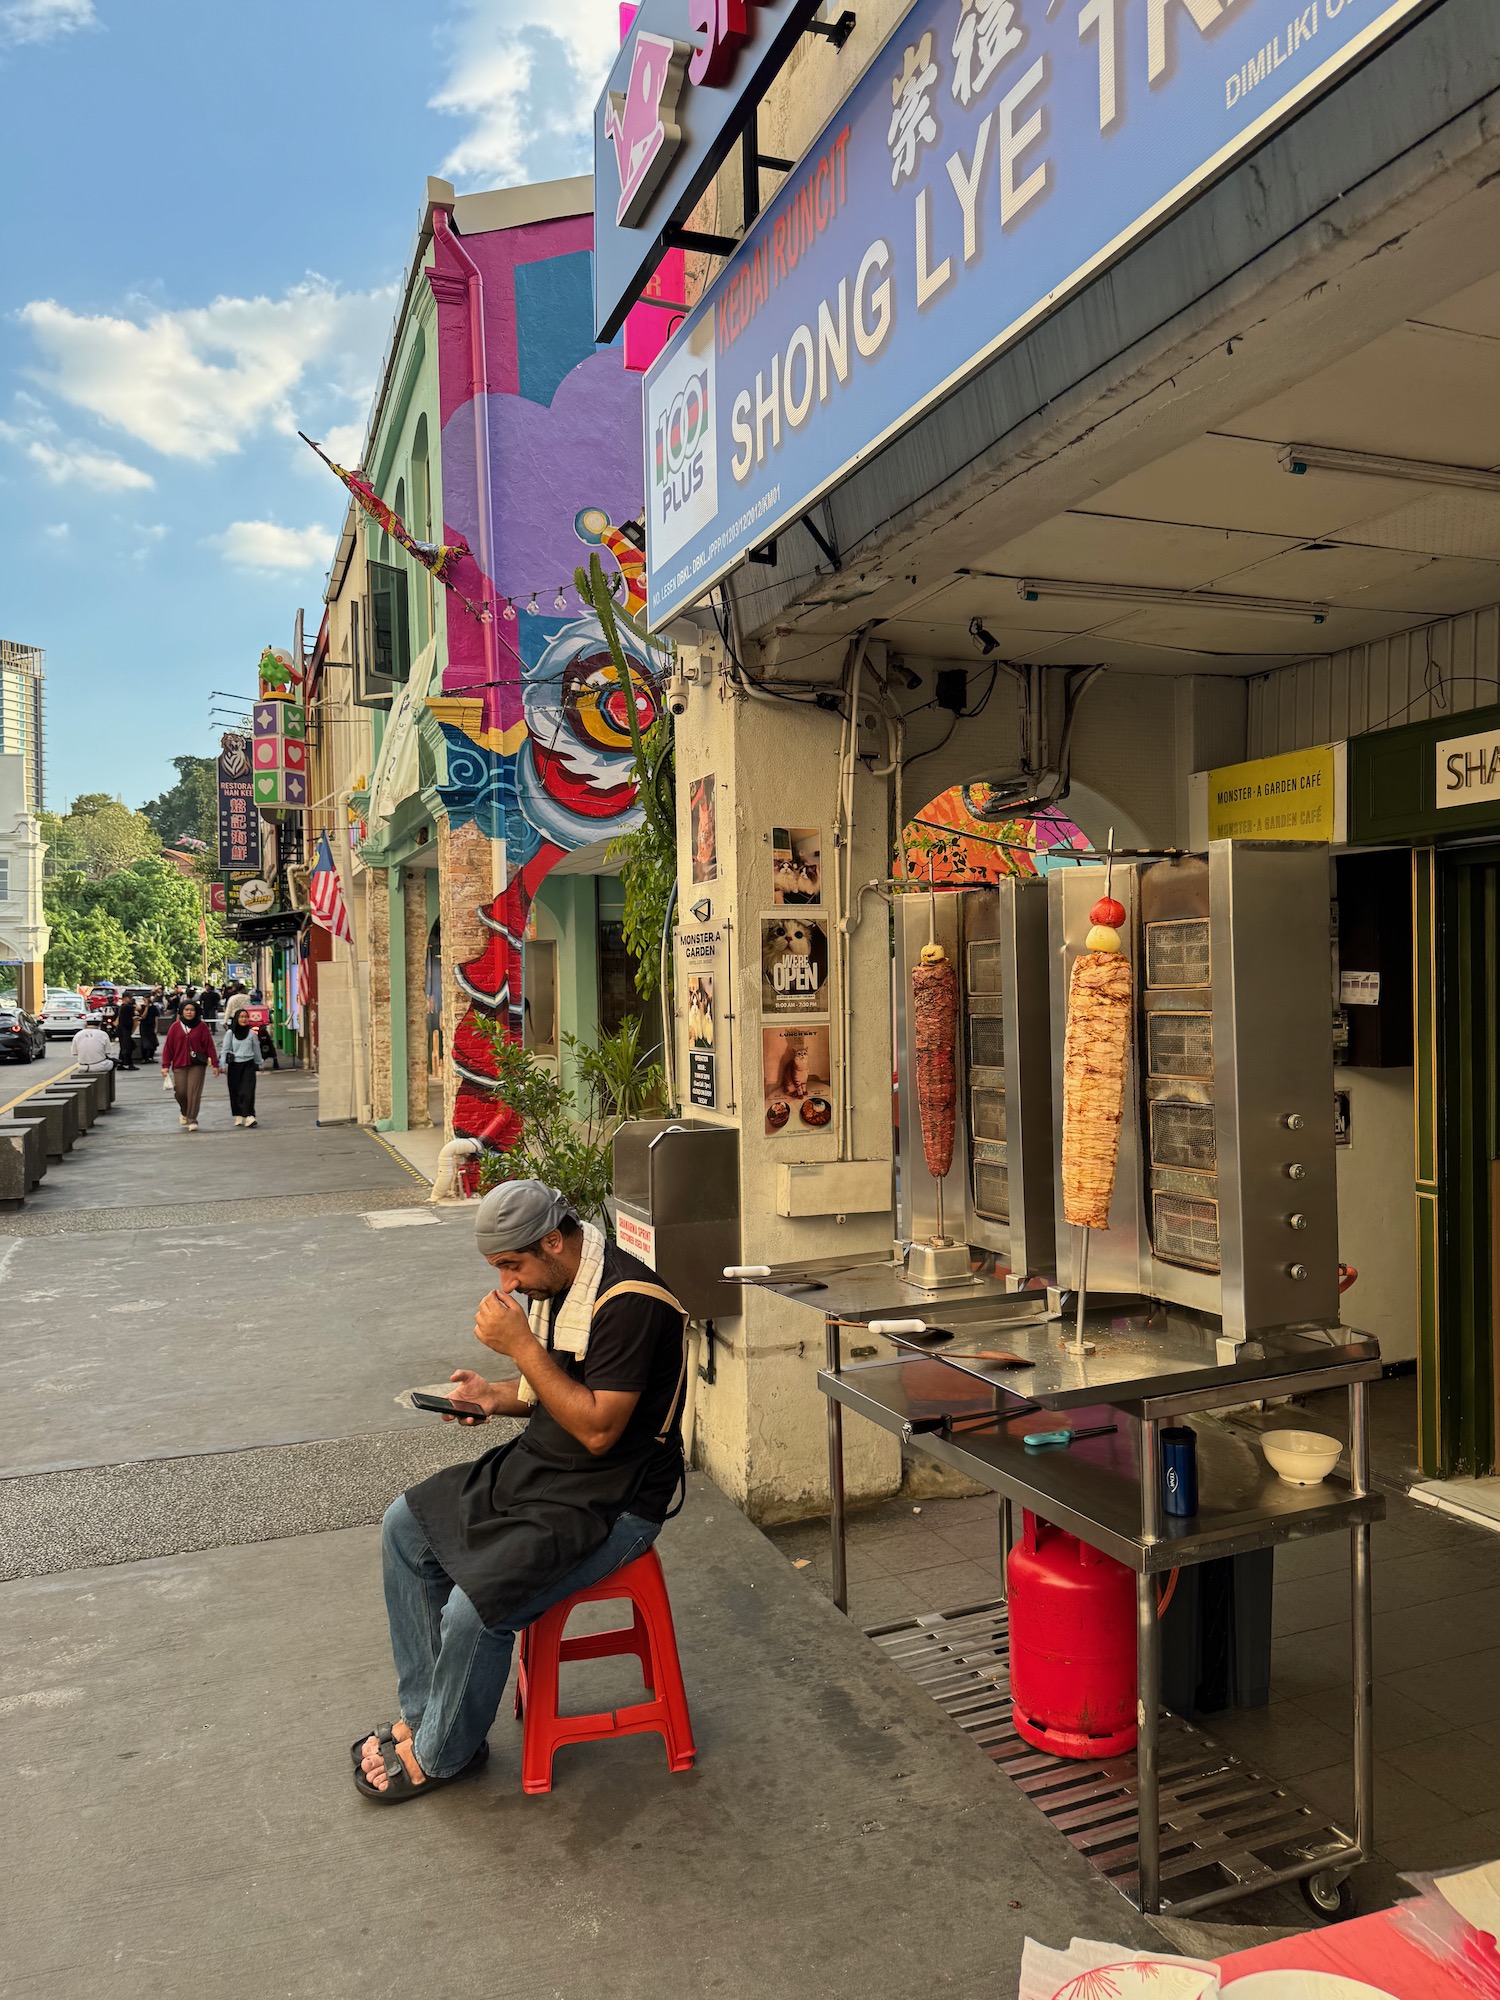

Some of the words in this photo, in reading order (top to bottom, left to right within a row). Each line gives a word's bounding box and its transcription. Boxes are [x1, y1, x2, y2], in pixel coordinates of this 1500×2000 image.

[1226, 2, 1318, 110] DIMILIKI
[718, 236, 769, 355] KEDAI
[774, 124, 851, 288] RUNCIT
[732, 239, 892, 481] SHONG
[916, 55, 1046, 308] LYE
[656, 374, 709, 488] 100
[663, 451, 704, 524] PLUS
[661, 576, 677, 601] LESEN
[224, 789, 240, 797] HAN
[241, 789, 254, 797] KEE
[1264, 778, 1297, 796] GARDEN
[1300, 770, 1322, 789] CAFÉ
[1264, 812, 1297, 830] GARDEN
[1300, 805, 1322, 825] CAFÉ
[680, 932, 714, 946] MONSTER
[685, 945, 716, 958] GARDEN
[773, 962, 818, 991] OPEN
